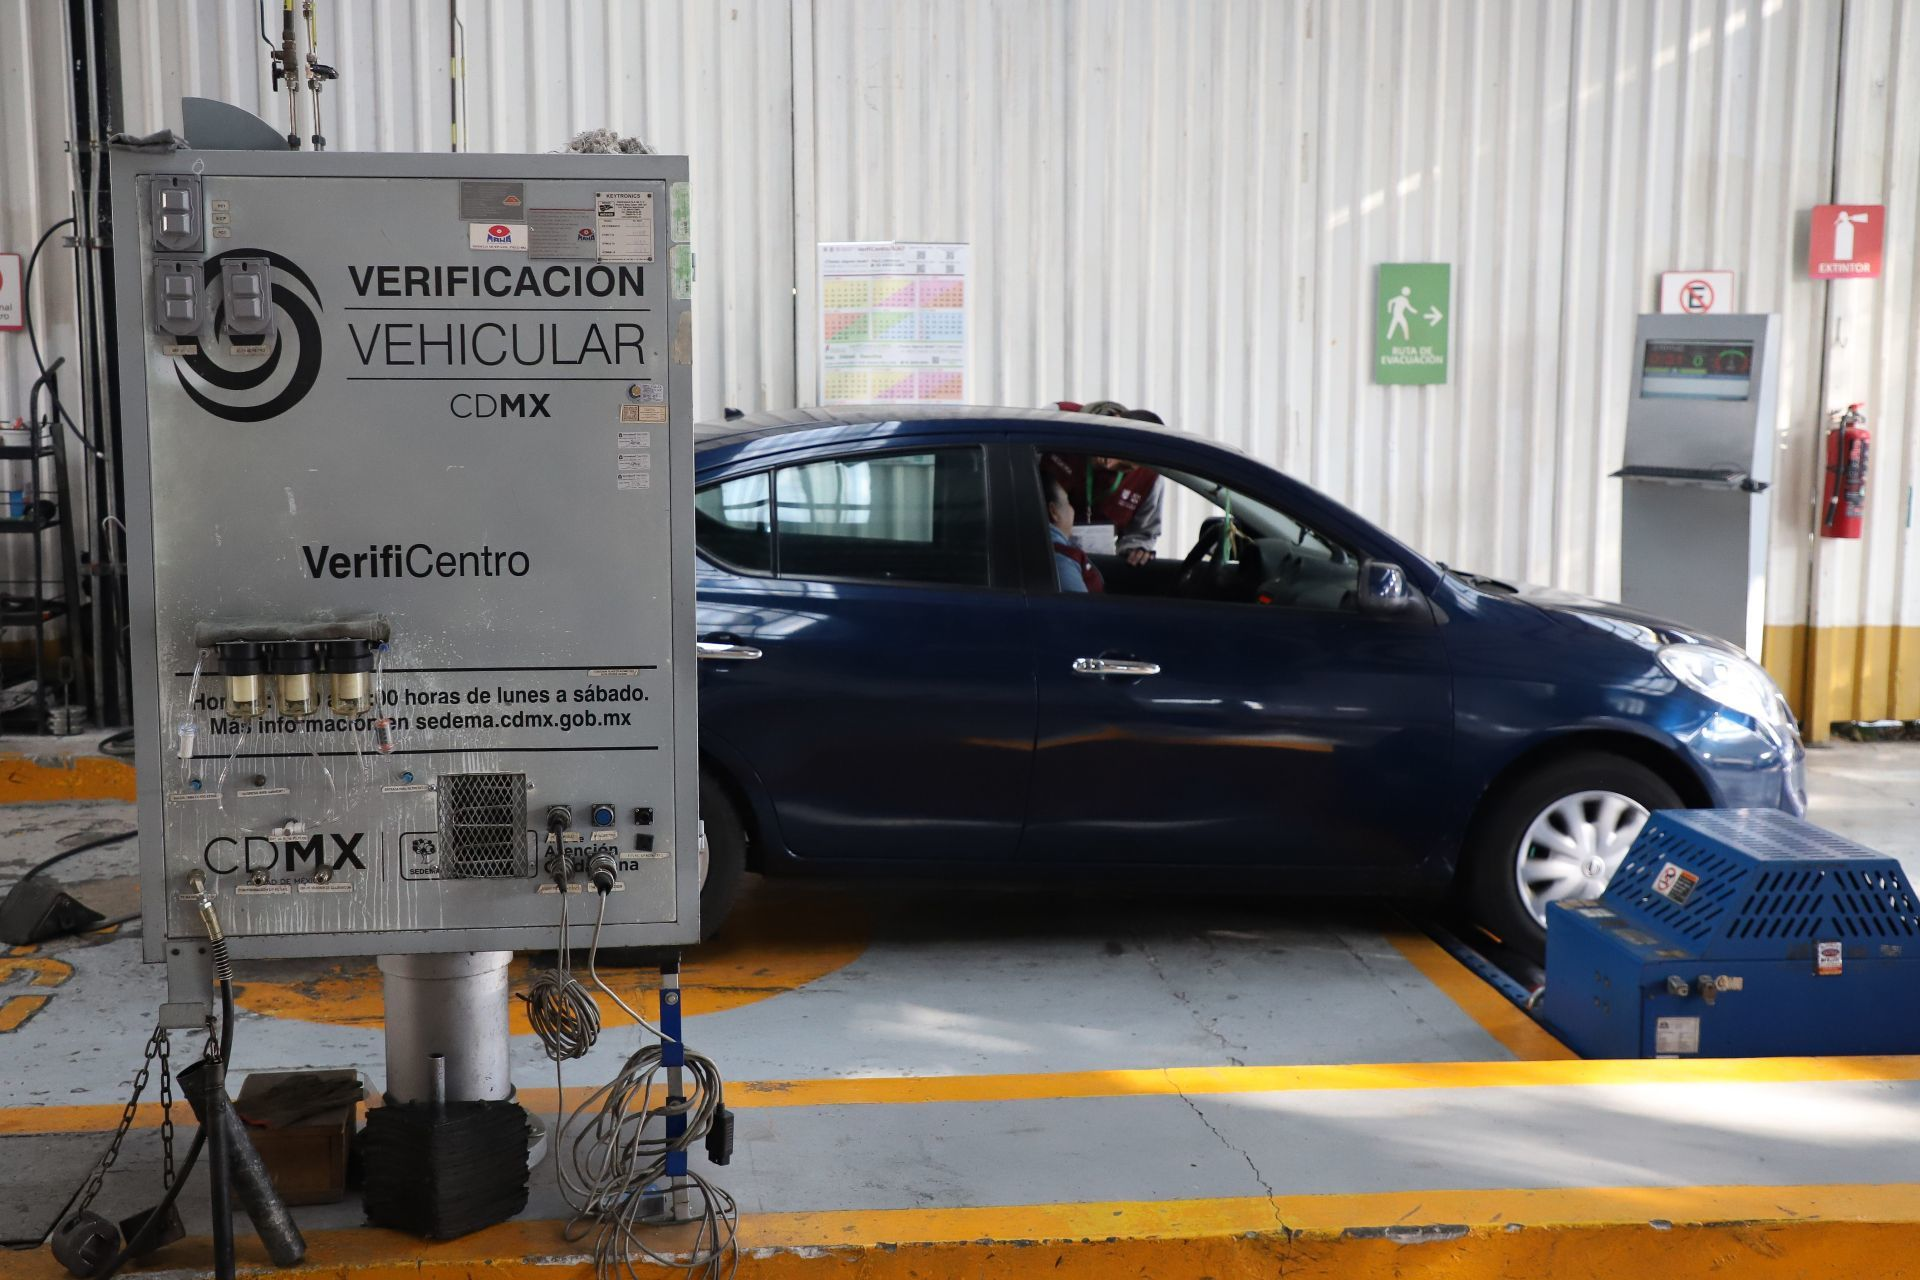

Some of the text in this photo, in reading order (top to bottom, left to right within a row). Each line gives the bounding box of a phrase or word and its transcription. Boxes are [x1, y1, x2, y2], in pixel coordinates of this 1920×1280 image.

[1818, 262, 1871, 274] EXTINTOR
[348, 323, 644, 366] VEHICULAR
[451, 394, 552, 418] CDMX
[302, 544, 530, 579] VerifiCentro
[406, 688, 460, 706] horas
[467, 687, 491, 704] de
[497, 687, 550, 704] lunes
[556, 690, 567, 703] a
[573, 684, 649, 702] sábado.
[415, 710, 632, 731] sedema.cdmx.gob.mx
[204, 833, 367, 875] CDMX
[544, 843, 618, 858] Aención
